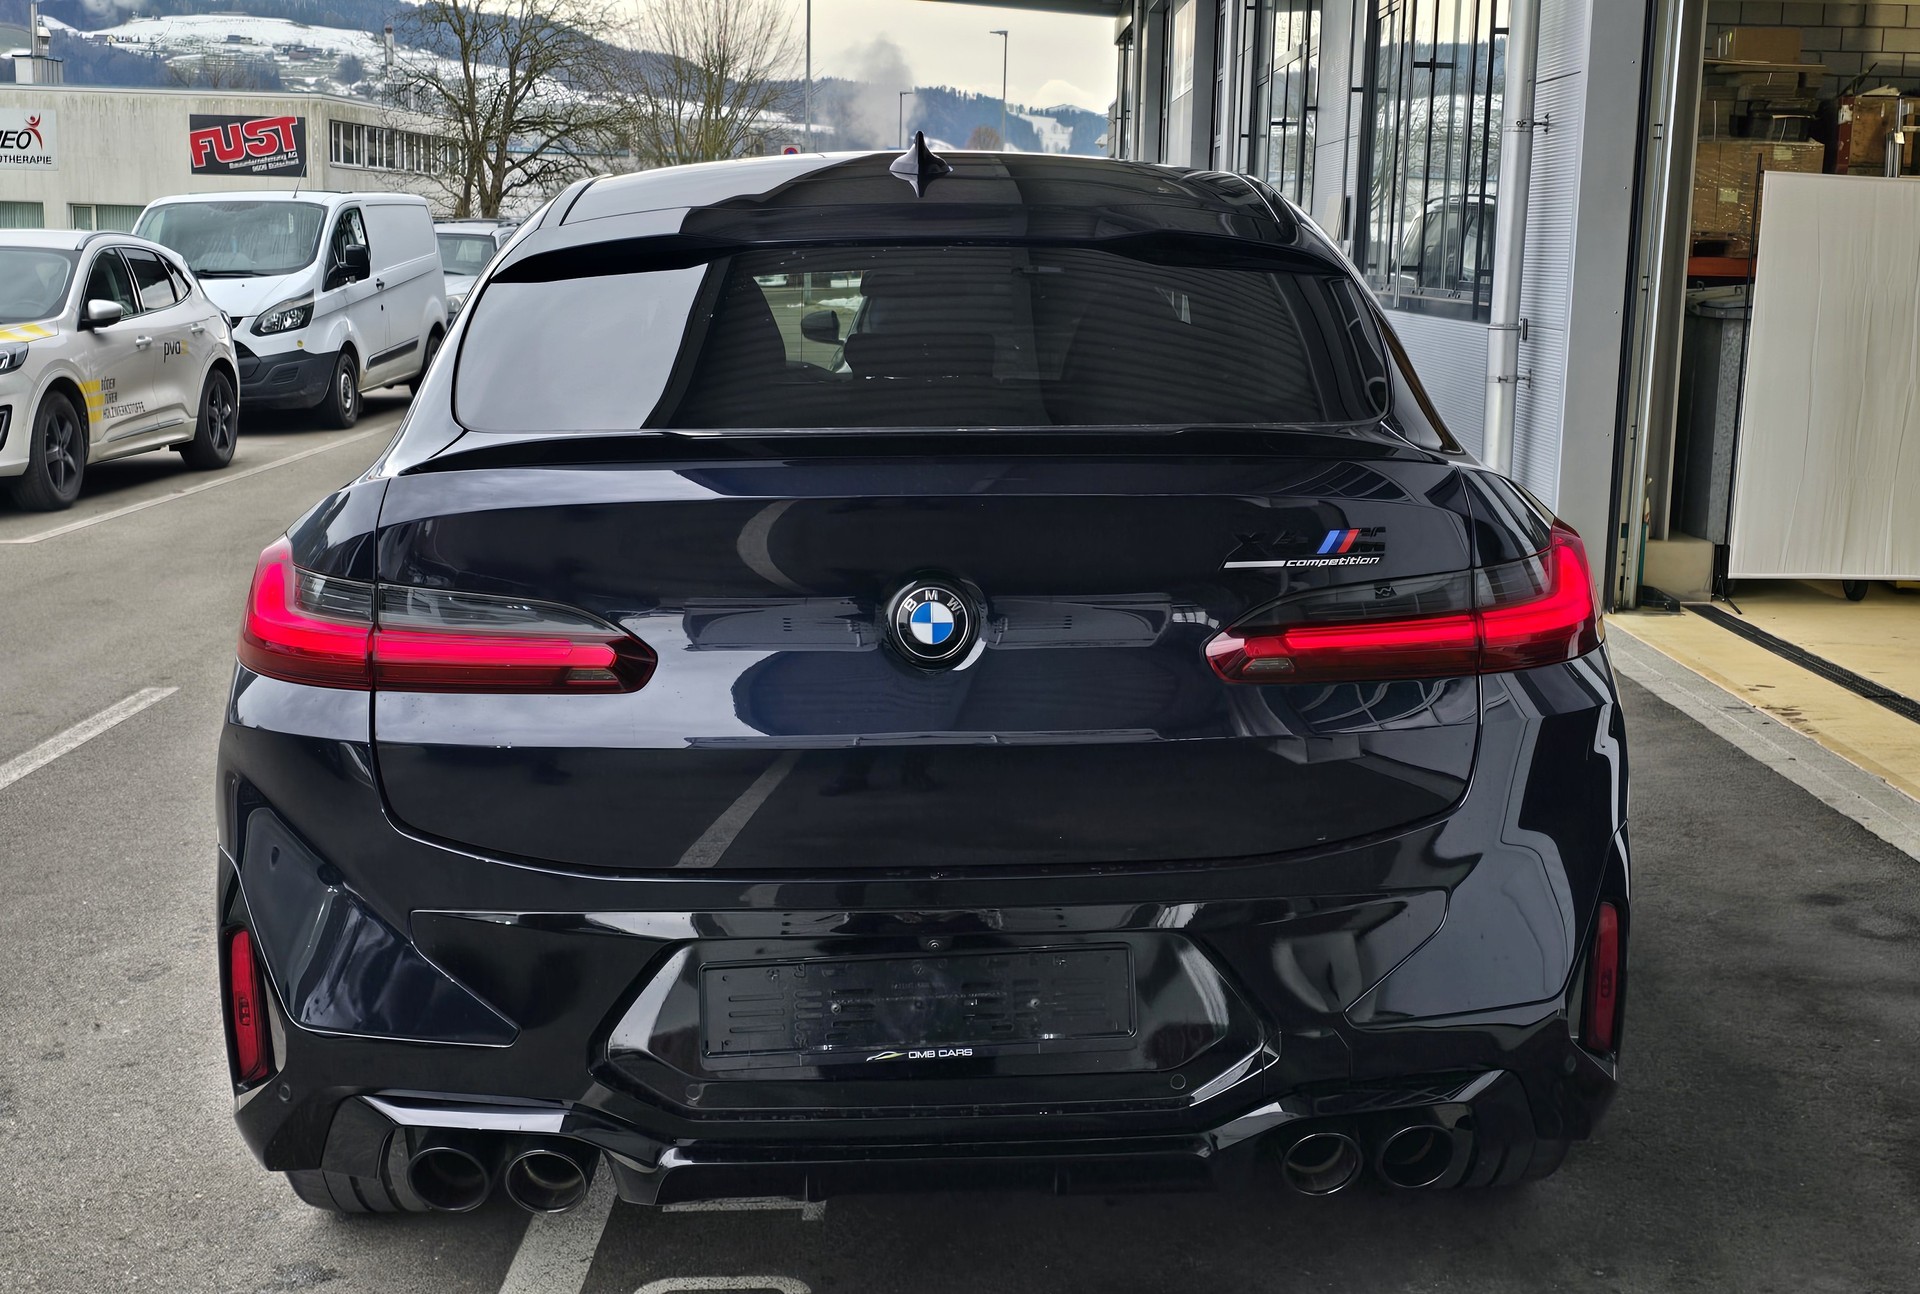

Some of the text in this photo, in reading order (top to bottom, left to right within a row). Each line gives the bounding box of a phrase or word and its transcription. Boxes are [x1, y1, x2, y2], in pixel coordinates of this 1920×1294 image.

[190, 116, 298, 168] FUST
[1286, 556, 1381, 567] competition
[904, 590, 962, 612] BMW
[938, 1048, 973, 1058] CARS
